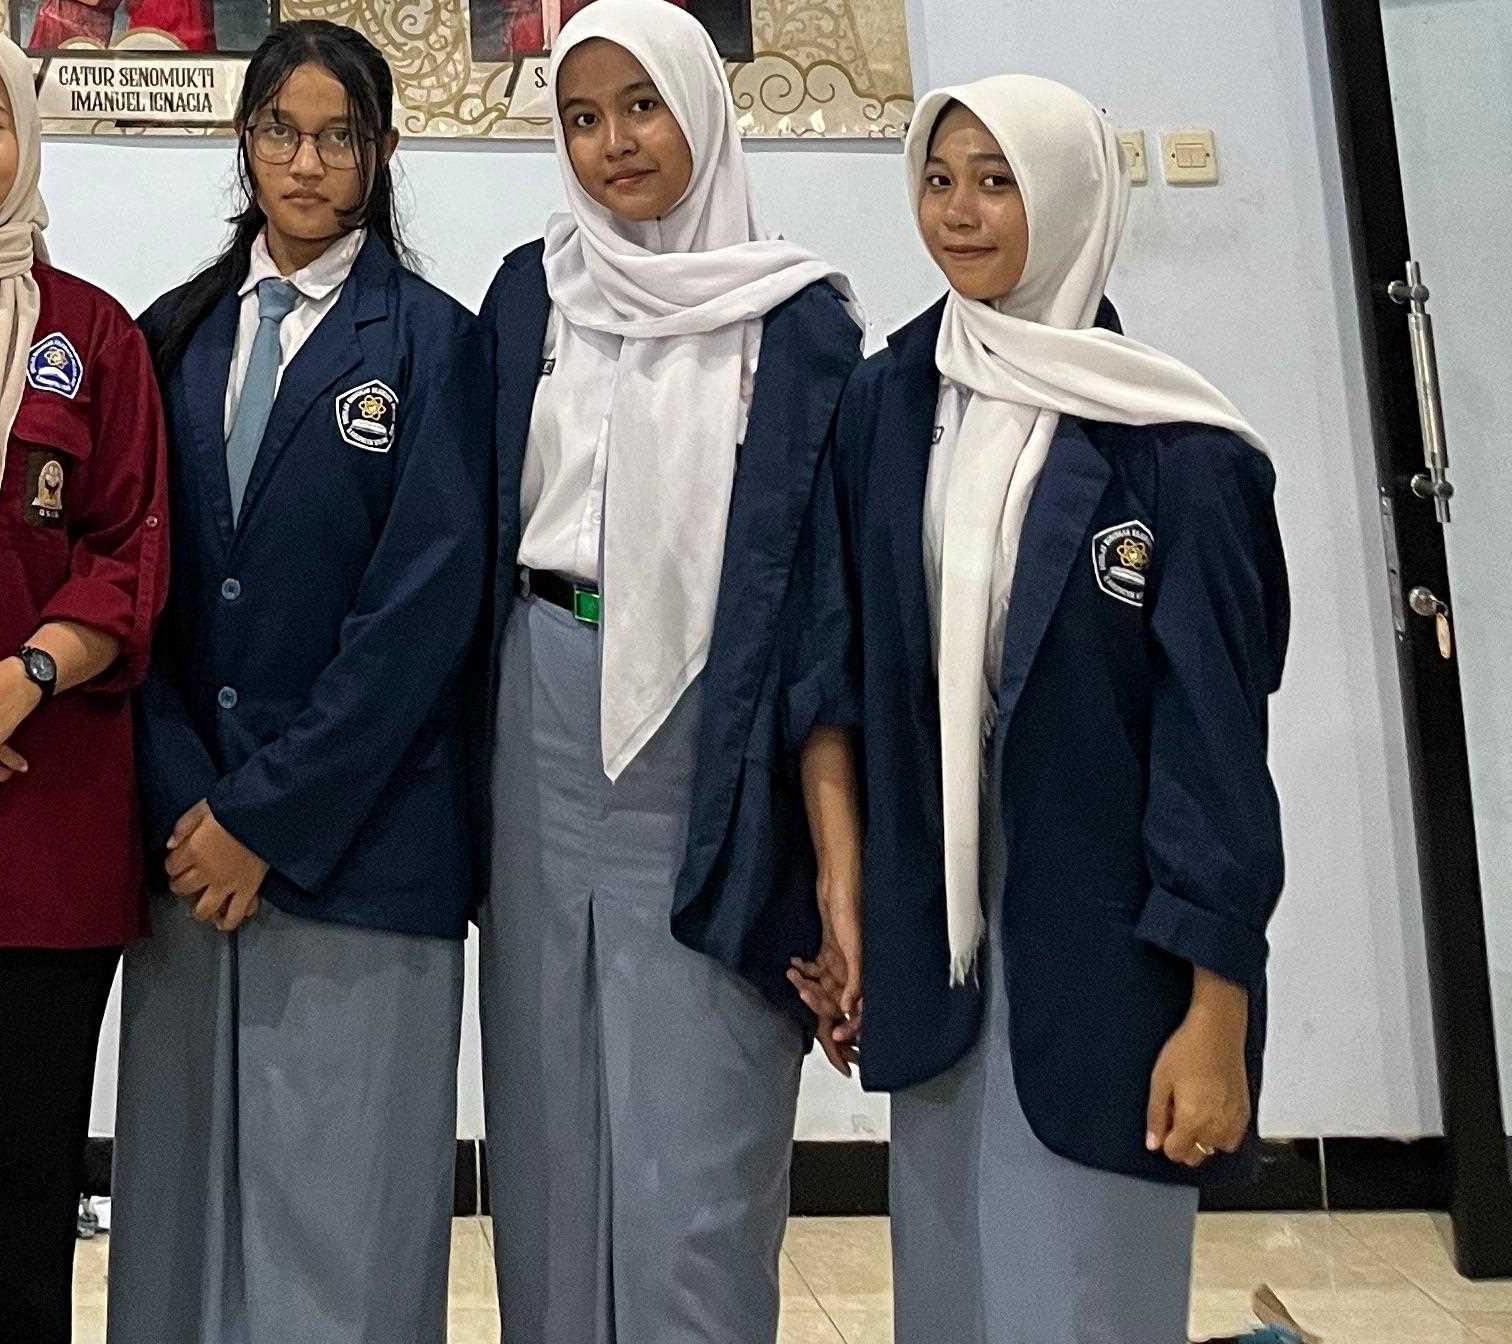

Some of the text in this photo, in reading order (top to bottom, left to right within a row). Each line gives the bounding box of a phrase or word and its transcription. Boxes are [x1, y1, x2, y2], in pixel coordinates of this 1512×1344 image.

[59, 65, 215, 89] CATUR SENOMUKTI
[71, 90, 145, 112] IMANUEL
